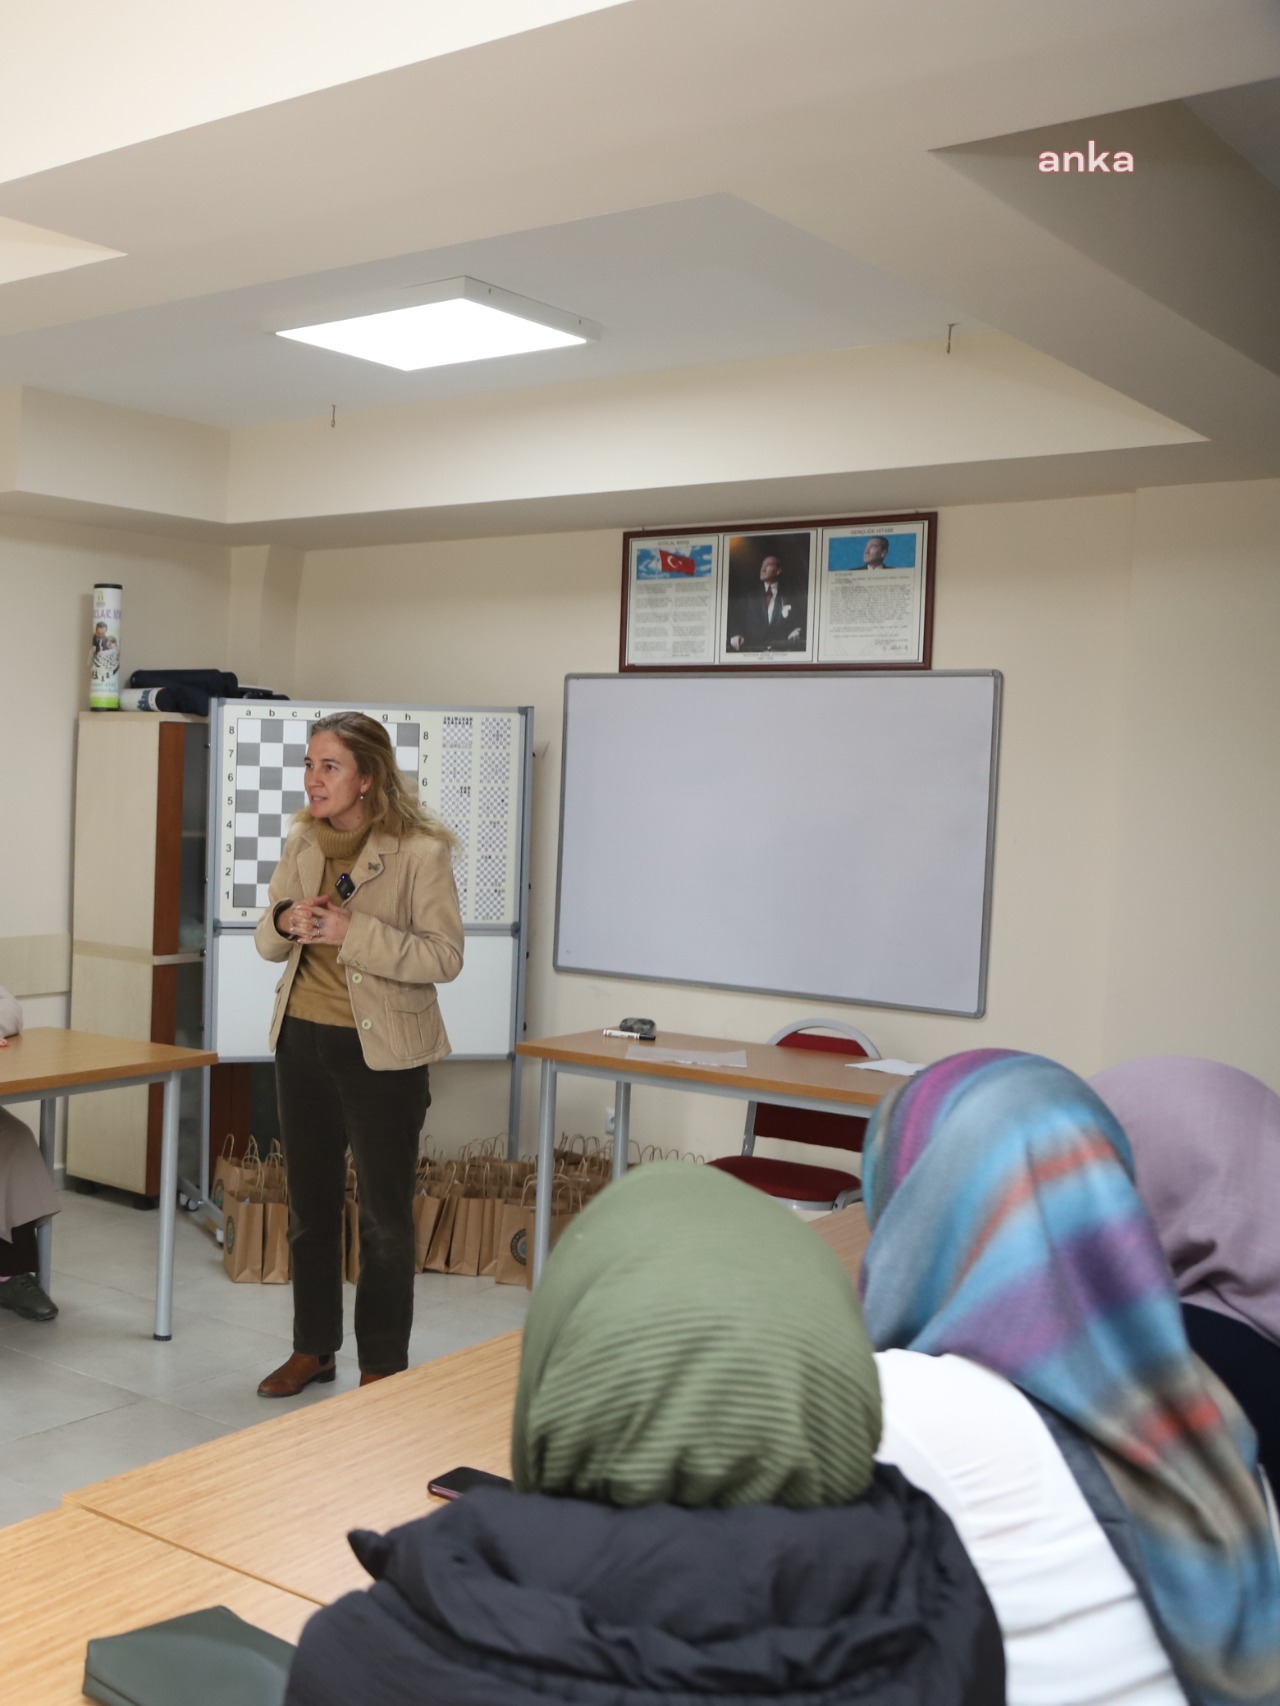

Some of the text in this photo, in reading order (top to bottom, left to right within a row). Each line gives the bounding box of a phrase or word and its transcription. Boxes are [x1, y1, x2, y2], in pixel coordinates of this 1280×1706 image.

[228, 725, 235, 735] 8
[423, 730, 429, 740] 8
[228, 749, 234, 758] 7
[422, 754, 429, 764] 7
[227, 772, 234, 782] 6
[421, 777, 428, 787] 6
[227, 796, 233, 806] 5
[226, 820, 233, 829] 4
[225, 843, 232, 853] 3
[225, 867, 232, 876] 2
[225, 891, 230, 900] 1
